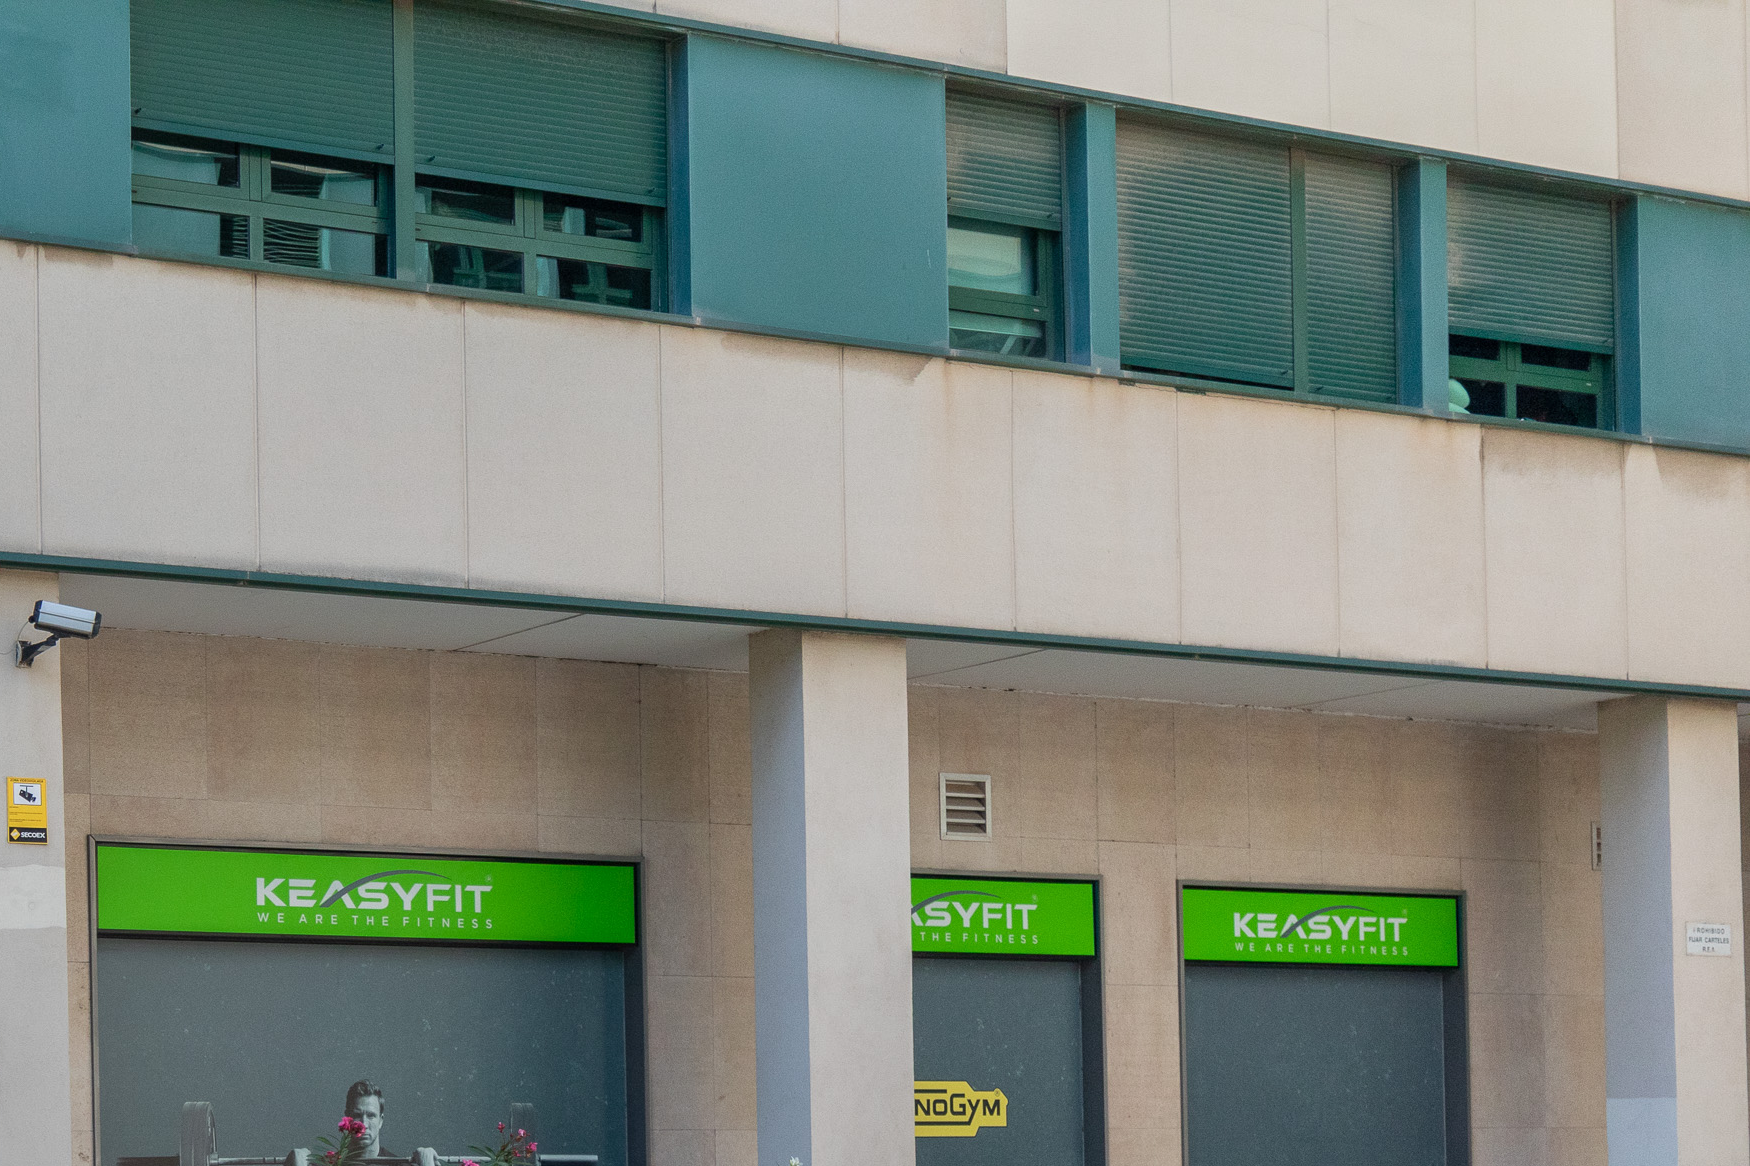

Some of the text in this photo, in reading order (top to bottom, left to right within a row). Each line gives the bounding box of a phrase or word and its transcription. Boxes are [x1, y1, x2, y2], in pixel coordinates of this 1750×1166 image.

[256, 877, 493, 913] KEASYFIT
[257, 912, 493, 929] WE ARE THE FITNESS
[1234, 912, 1408, 942] KEASYFIT
[920, 932, 1038, 944] THE FITNESS
[1235, 942, 1408, 956] WE ARE THE FITNESS
